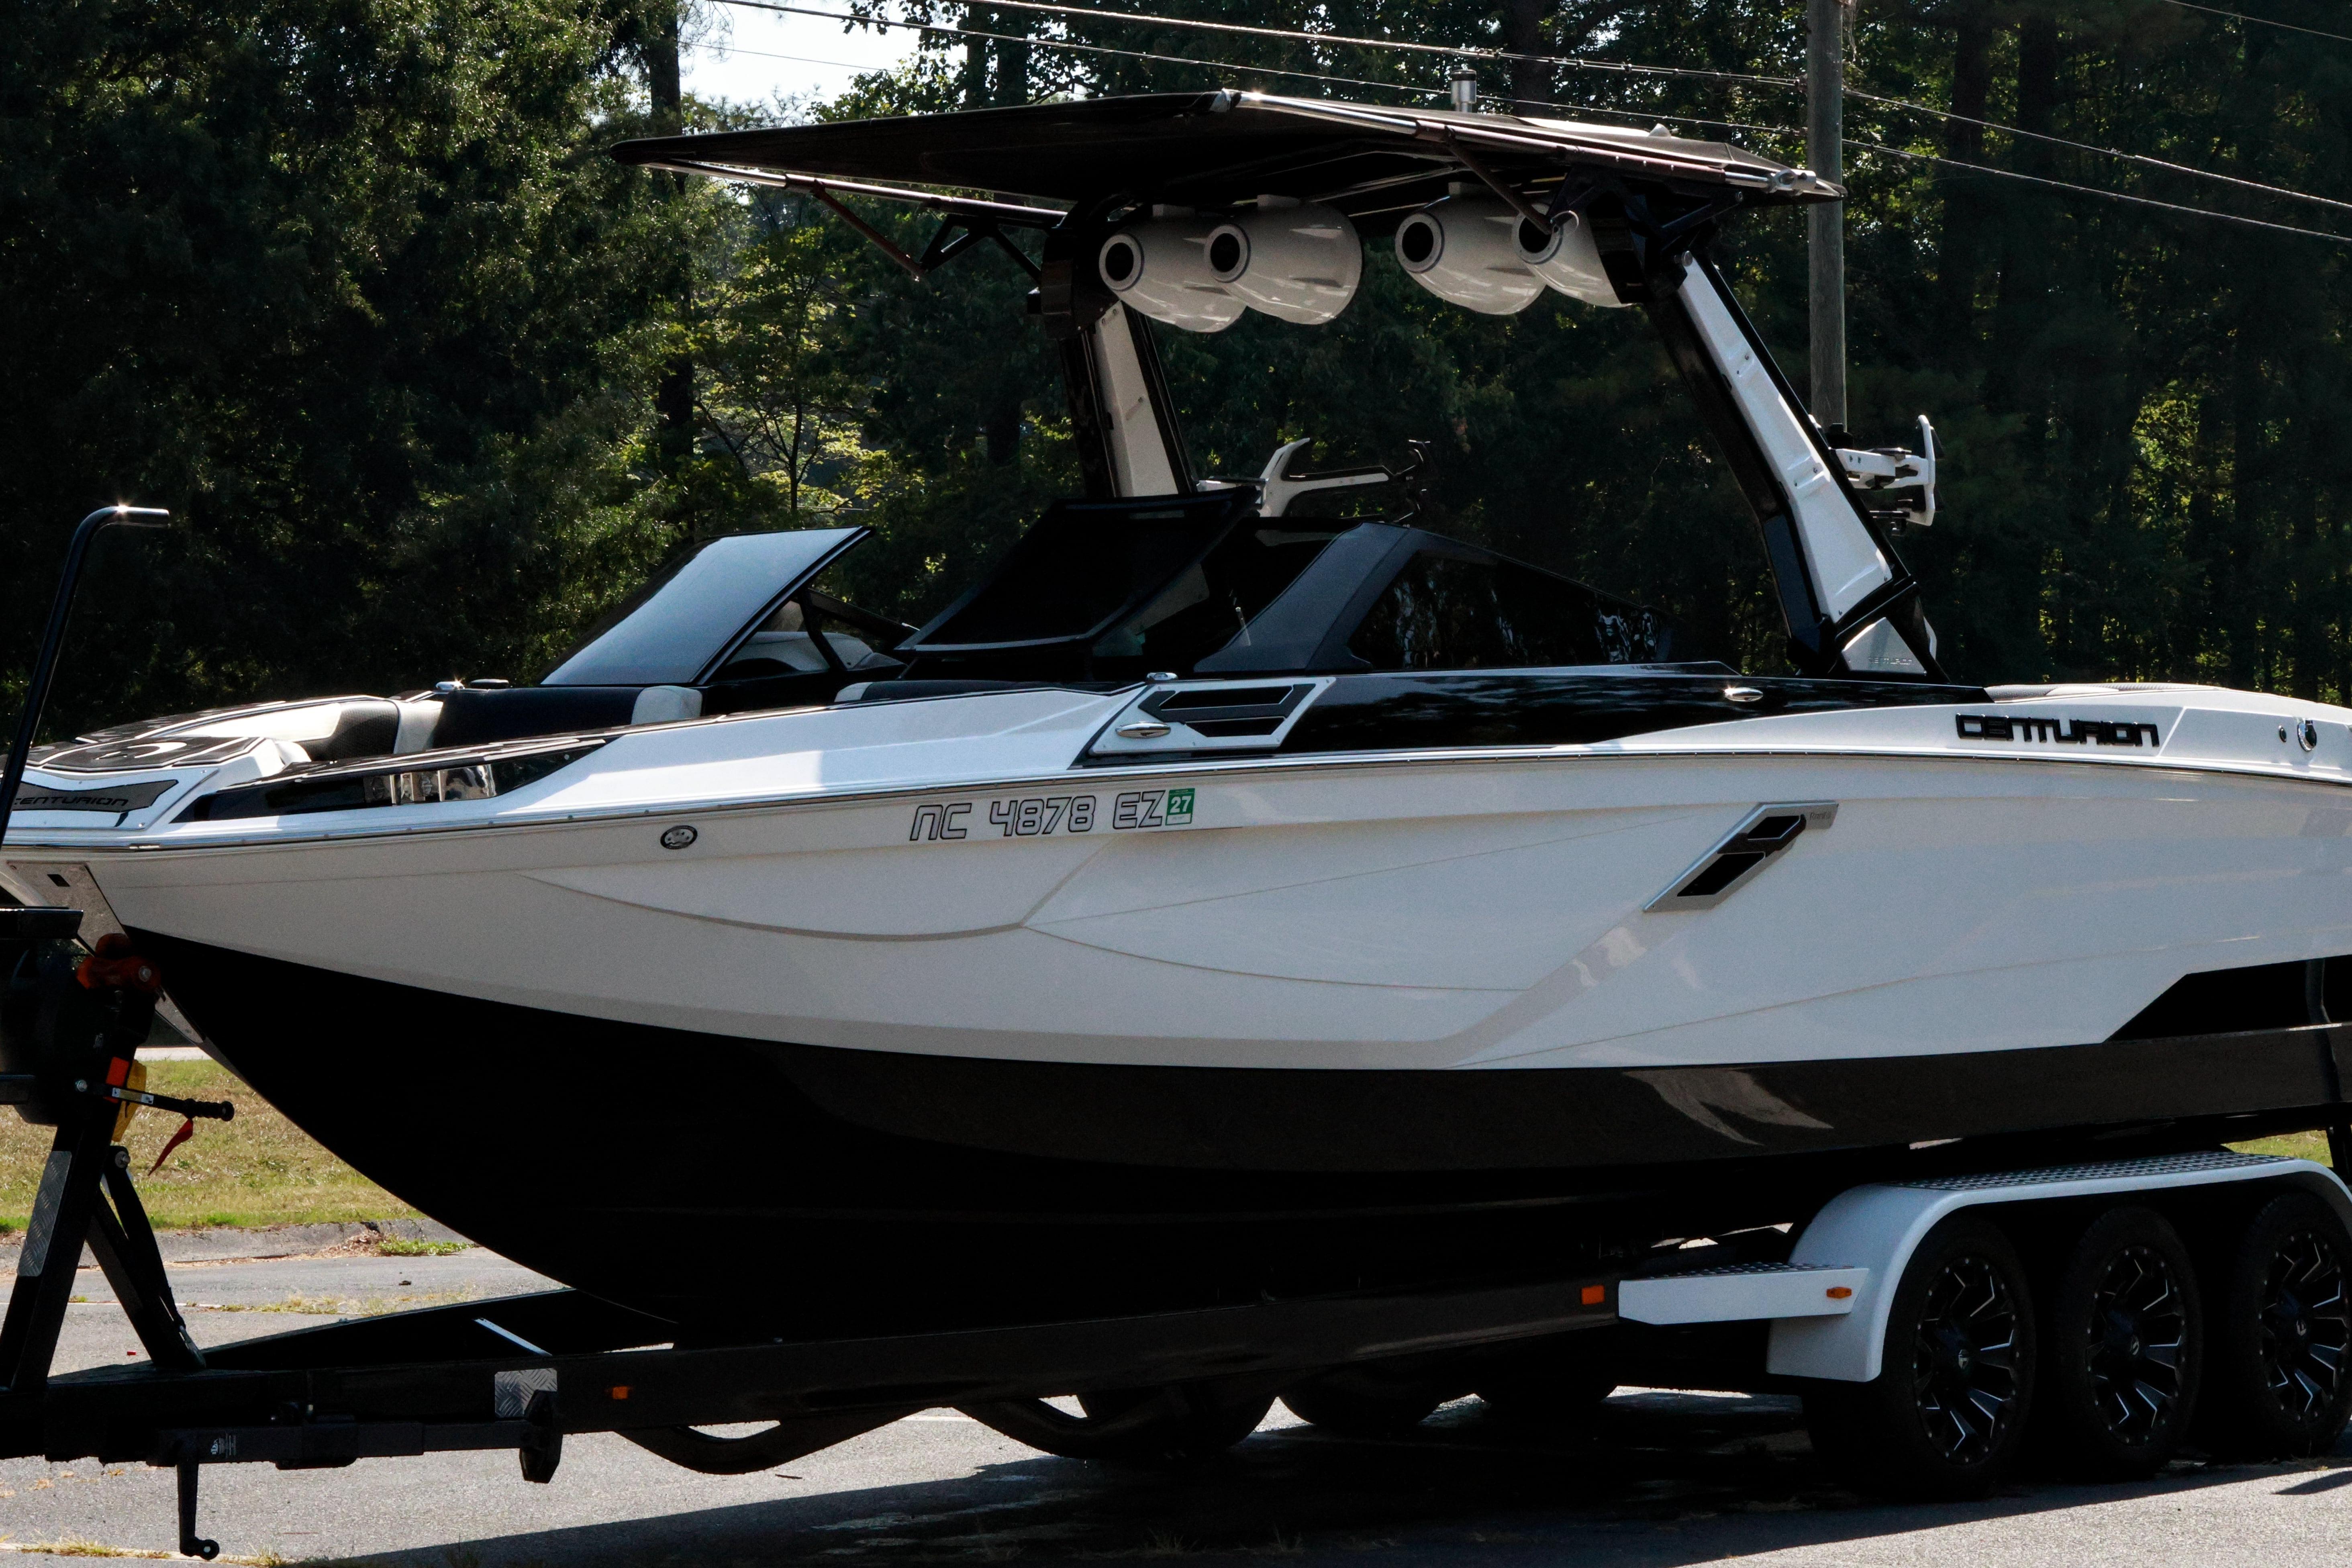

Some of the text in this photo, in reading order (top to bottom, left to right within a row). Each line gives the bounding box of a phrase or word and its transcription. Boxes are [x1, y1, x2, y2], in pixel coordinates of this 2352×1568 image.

[1956, 713, 2159, 747] CENTURION
[910, 790, 1166, 841] NC 4878 EZ
[1170, 795, 1192, 813] 27
